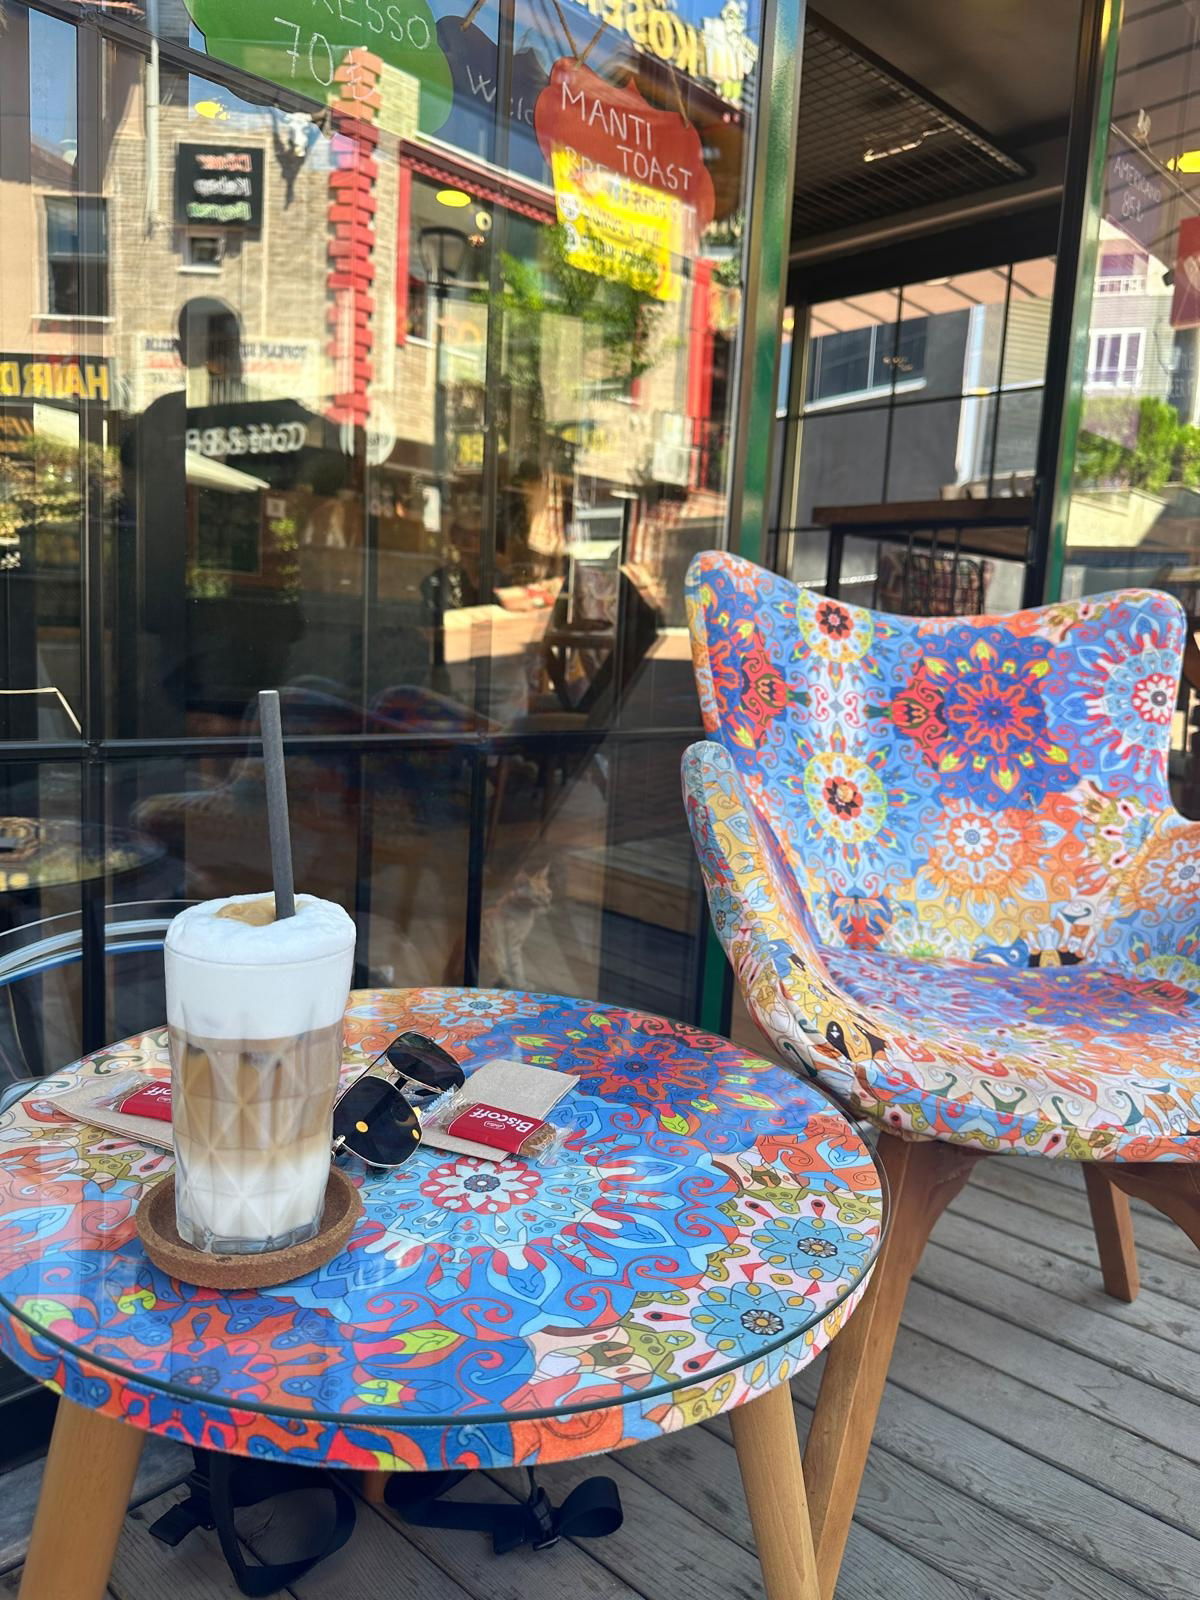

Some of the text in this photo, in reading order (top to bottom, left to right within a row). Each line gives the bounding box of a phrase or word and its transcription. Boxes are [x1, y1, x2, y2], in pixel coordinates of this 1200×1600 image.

[560, 81, 653, 152] MANTI
[616, 144, 694, 192] TOAST
[468, 1107, 535, 1133] Biscoff
